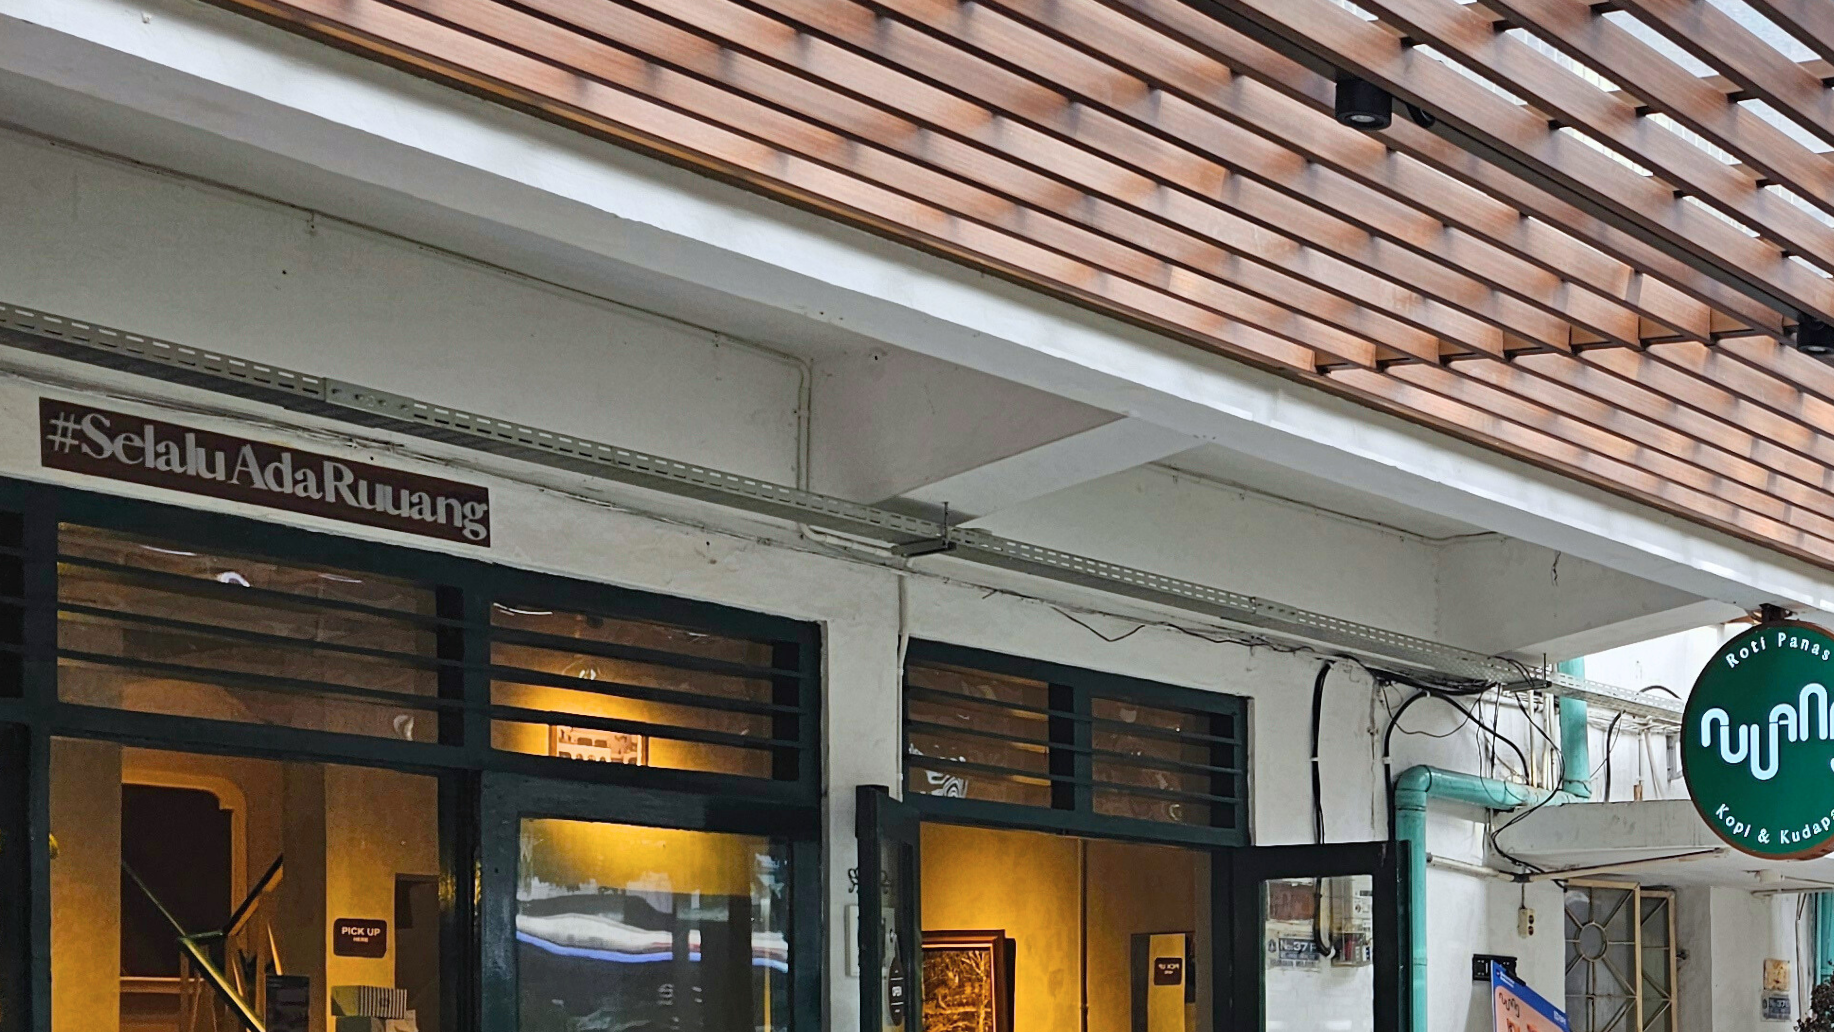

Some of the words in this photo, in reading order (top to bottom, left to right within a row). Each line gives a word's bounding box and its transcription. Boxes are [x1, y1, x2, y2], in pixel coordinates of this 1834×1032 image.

[47, 411, 488, 541] #SelaluAdaRuuang
[1725, 636, 1766, 668] Roti
[1777, 632, 1831, 661] Panas
[1715, 803, 1751, 838] Kopi
[1757, 828, 1770, 844] &
[341, 926, 365, 936] PICK
[366, 927, 381, 937] UP
